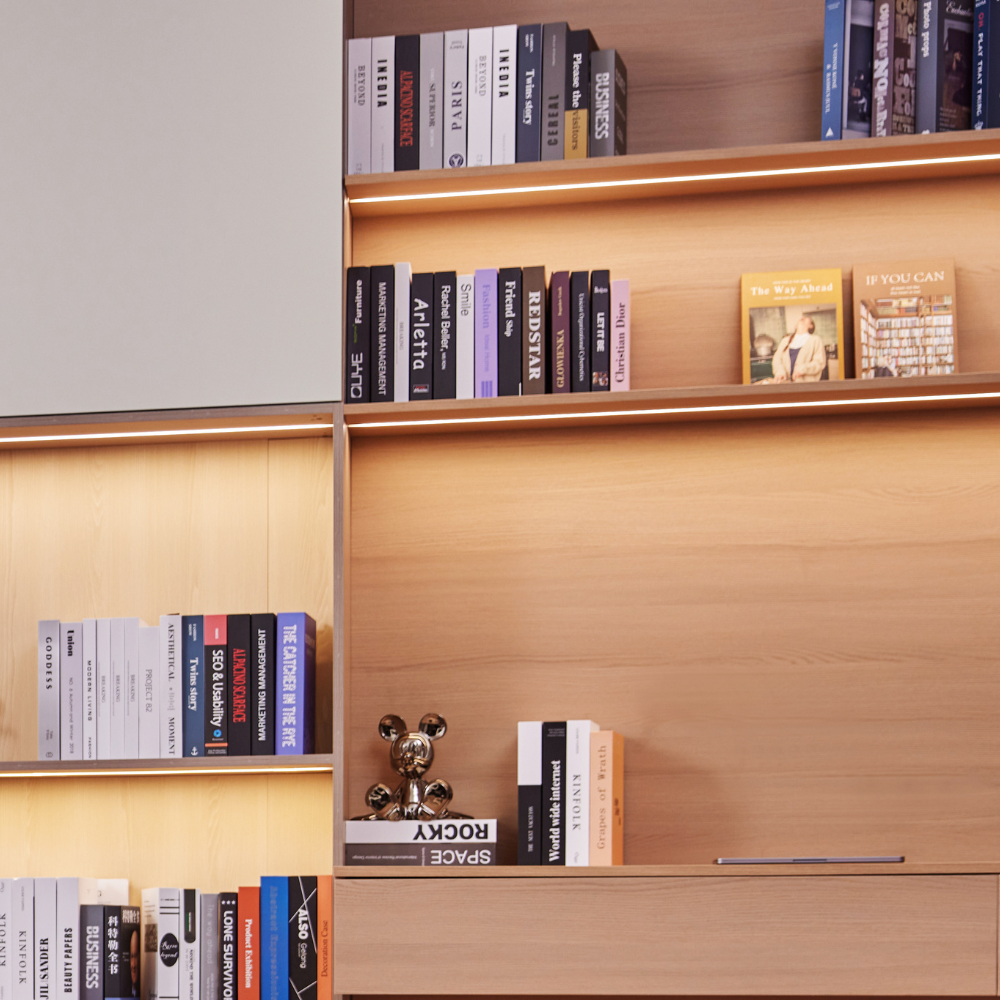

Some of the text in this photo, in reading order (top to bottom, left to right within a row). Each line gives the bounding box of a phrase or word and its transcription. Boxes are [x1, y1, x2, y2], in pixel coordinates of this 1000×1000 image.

[921, 1, 932, 58] Photo props
[377, 60, 387, 108] INEDIA
[499, 49, 509, 98] INEDIA
[522, 68, 535, 125] Twins story
[452, 81, 462, 130] PARIS
[548, 94, 558, 146] CEREAL
[572, 53, 582, 150] Please the visitors
[595, 72, 610, 140] BUSINESS
[441, 285, 451, 319] Rachel
[461, 284, 471, 316] Smile
[750, 287, 770, 296] The
[774, 285, 796, 295] Way
[800, 282, 833, 293] Ahead
[866, 270, 944, 286] IF YOU CAN
[482, 284, 491, 328] Fashion
[504, 281, 516, 337] Friend Ship
[378, 282, 386, 395] MARKETING MANAGEMENT
[413, 298, 430, 370] Arletta
[528, 290, 541, 380] REDSTAR
[597, 330, 604, 339] IT
[597, 340, 604, 352] BE
[615, 302, 625, 383] Christian Dior
[188, 657, 198, 711] Twins story
[212, 650, 223, 671] SEO
[212, 672, 223, 681] &
[258, 629, 266, 741] MARKETING MANAGEMENT
[146, 703, 152, 713] 82
[210, 682, 223, 727] Usability
[233, 686, 246, 723] SCARFACE
[281, 625, 297, 747] THE CATCHER IN THE RYE
[549, 760, 560, 862] World wide internet
[572, 774, 580, 830] KINFOLK
[597, 745, 607, 849] Grapes of Wrath
[413, 824, 488, 840] ROCKY
[431, 849, 491, 864] SPACE
[224, 910, 233, 941] LONE
[270, 886, 278, 931] Abstract
[298, 908, 308, 939] ALSO
[19, 931, 27, 985] KINFOLK
[40, 938, 49, 1000] JIL SANDER
[64, 927, 73, 993] BEAUTY PAPERS
[86, 925, 100, 989] BUSINESS
